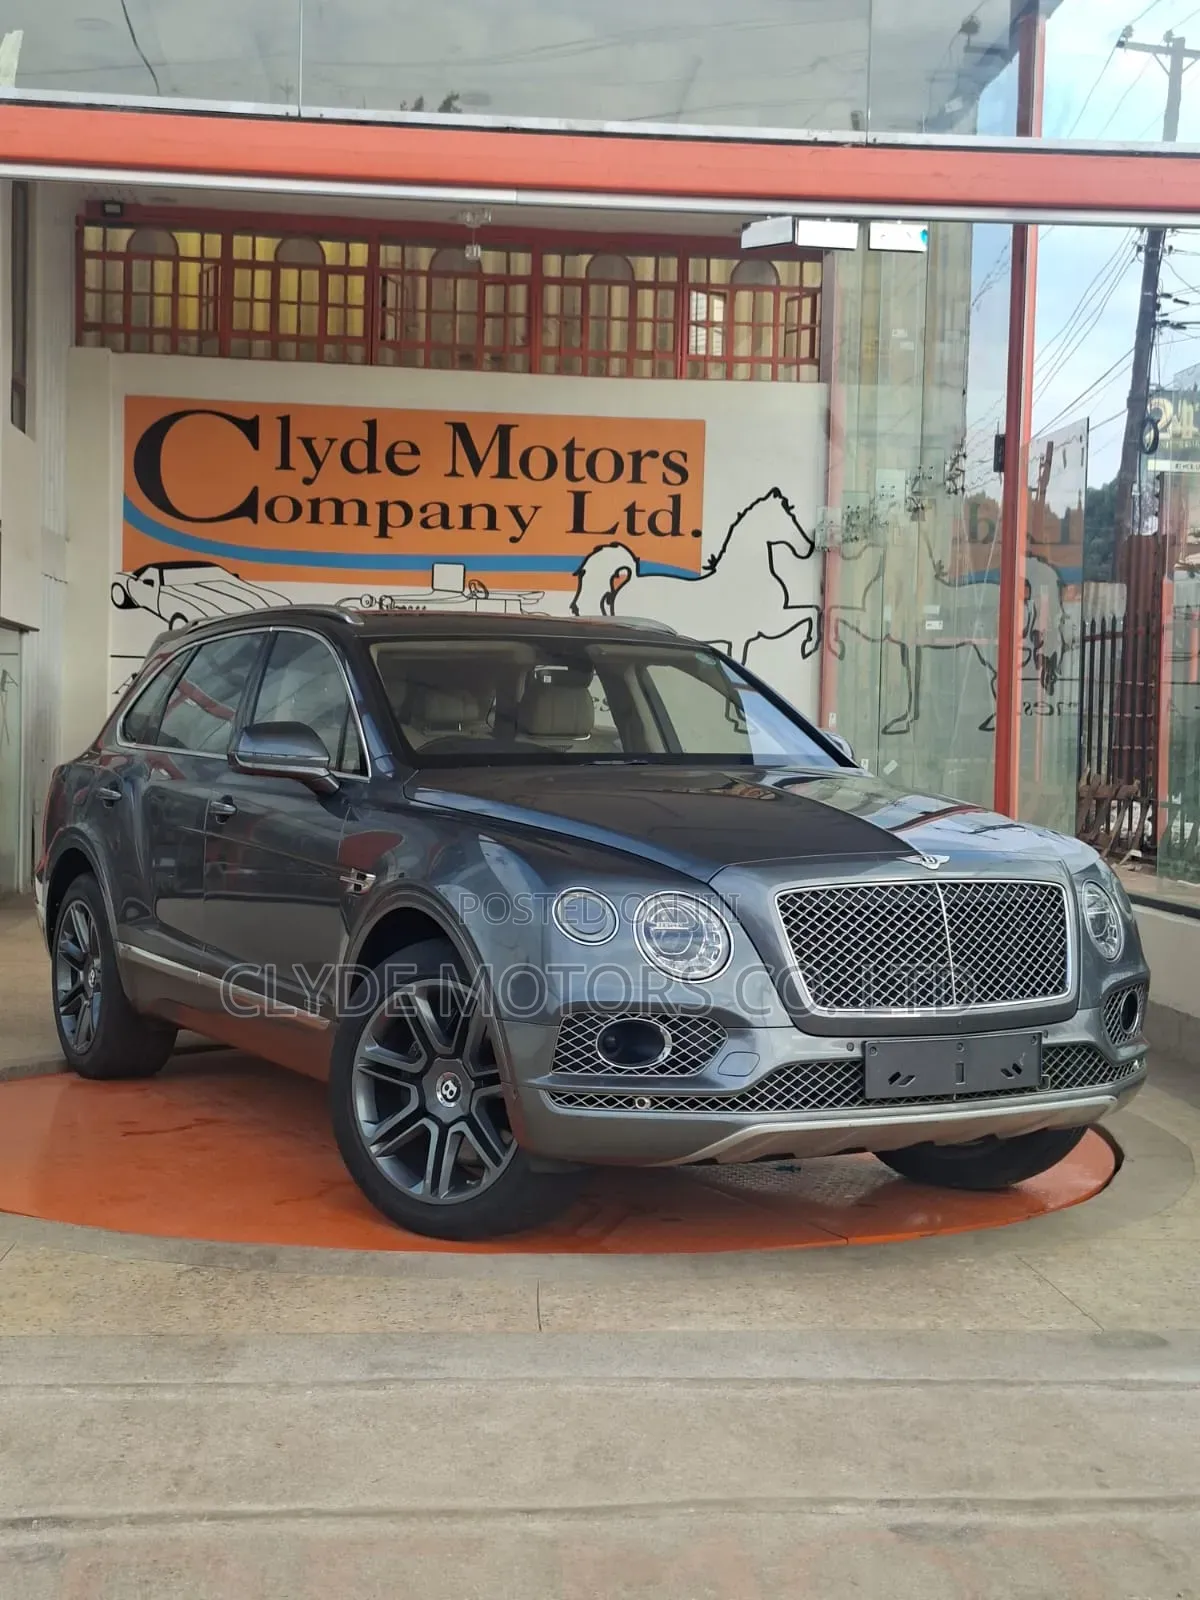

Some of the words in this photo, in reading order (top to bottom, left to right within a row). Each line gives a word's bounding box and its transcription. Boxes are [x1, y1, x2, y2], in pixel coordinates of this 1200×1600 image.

[133, 409, 421, 523] Clyde
[444, 421, 689, 486] Motors
[565, 490, 702, 537] Ltd.
